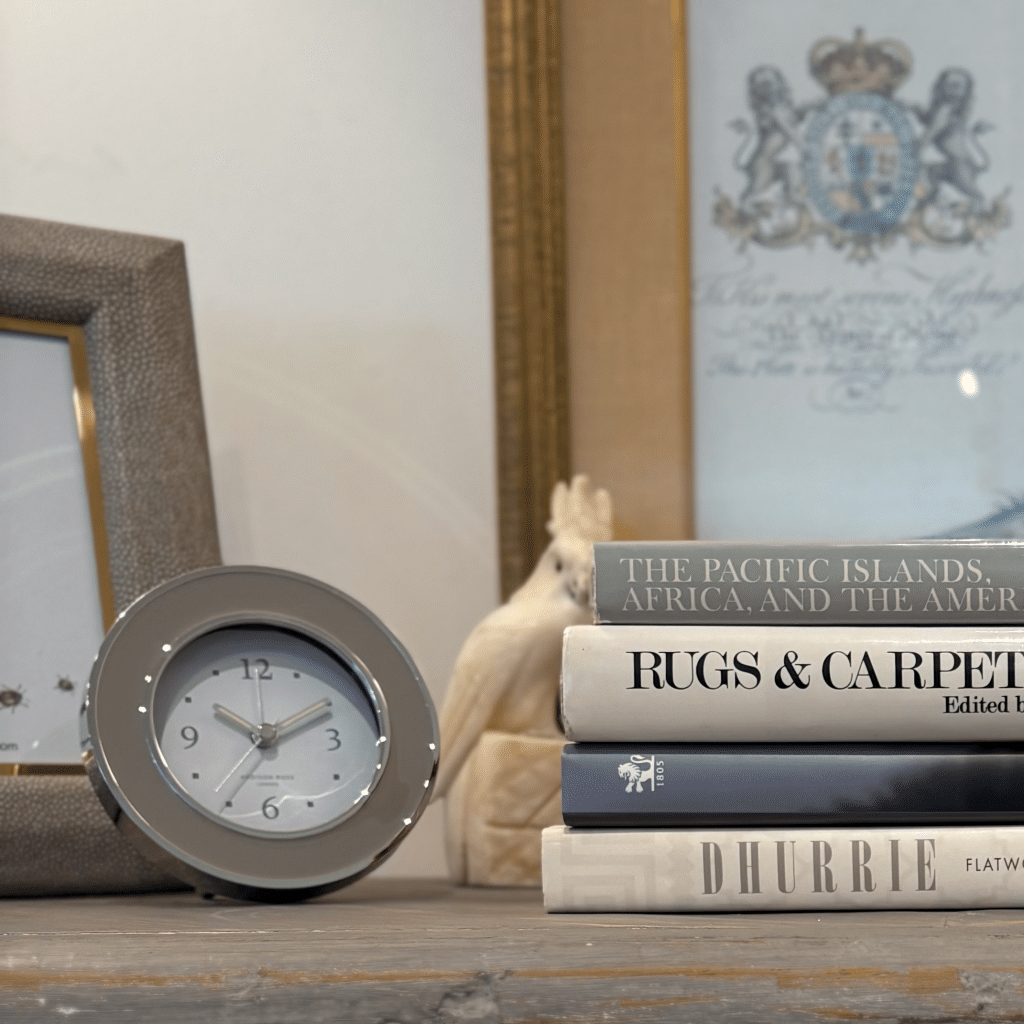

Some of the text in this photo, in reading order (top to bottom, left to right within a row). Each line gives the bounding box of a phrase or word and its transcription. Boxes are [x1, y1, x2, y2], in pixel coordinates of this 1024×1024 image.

[620, 558, 991, 585] THE PACIFIC ISLANDS,
[621, 587, 752, 615] AFRICA,
[760, 587, 831, 612] AND
[841, 587, 913, 612] THE
[241, 658, 273, 680] 12
[625, 650, 761, 690] RUGS
[774, 650, 811, 690] &
[942, 695, 1010, 714] Edited
[181, 726, 199, 750] 9
[325, 728, 342, 751] 3
[656, 760, 665, 786] 1805
[262, 796, 279, 819] 6
[700, 838, 937, 894] DHURRIE
